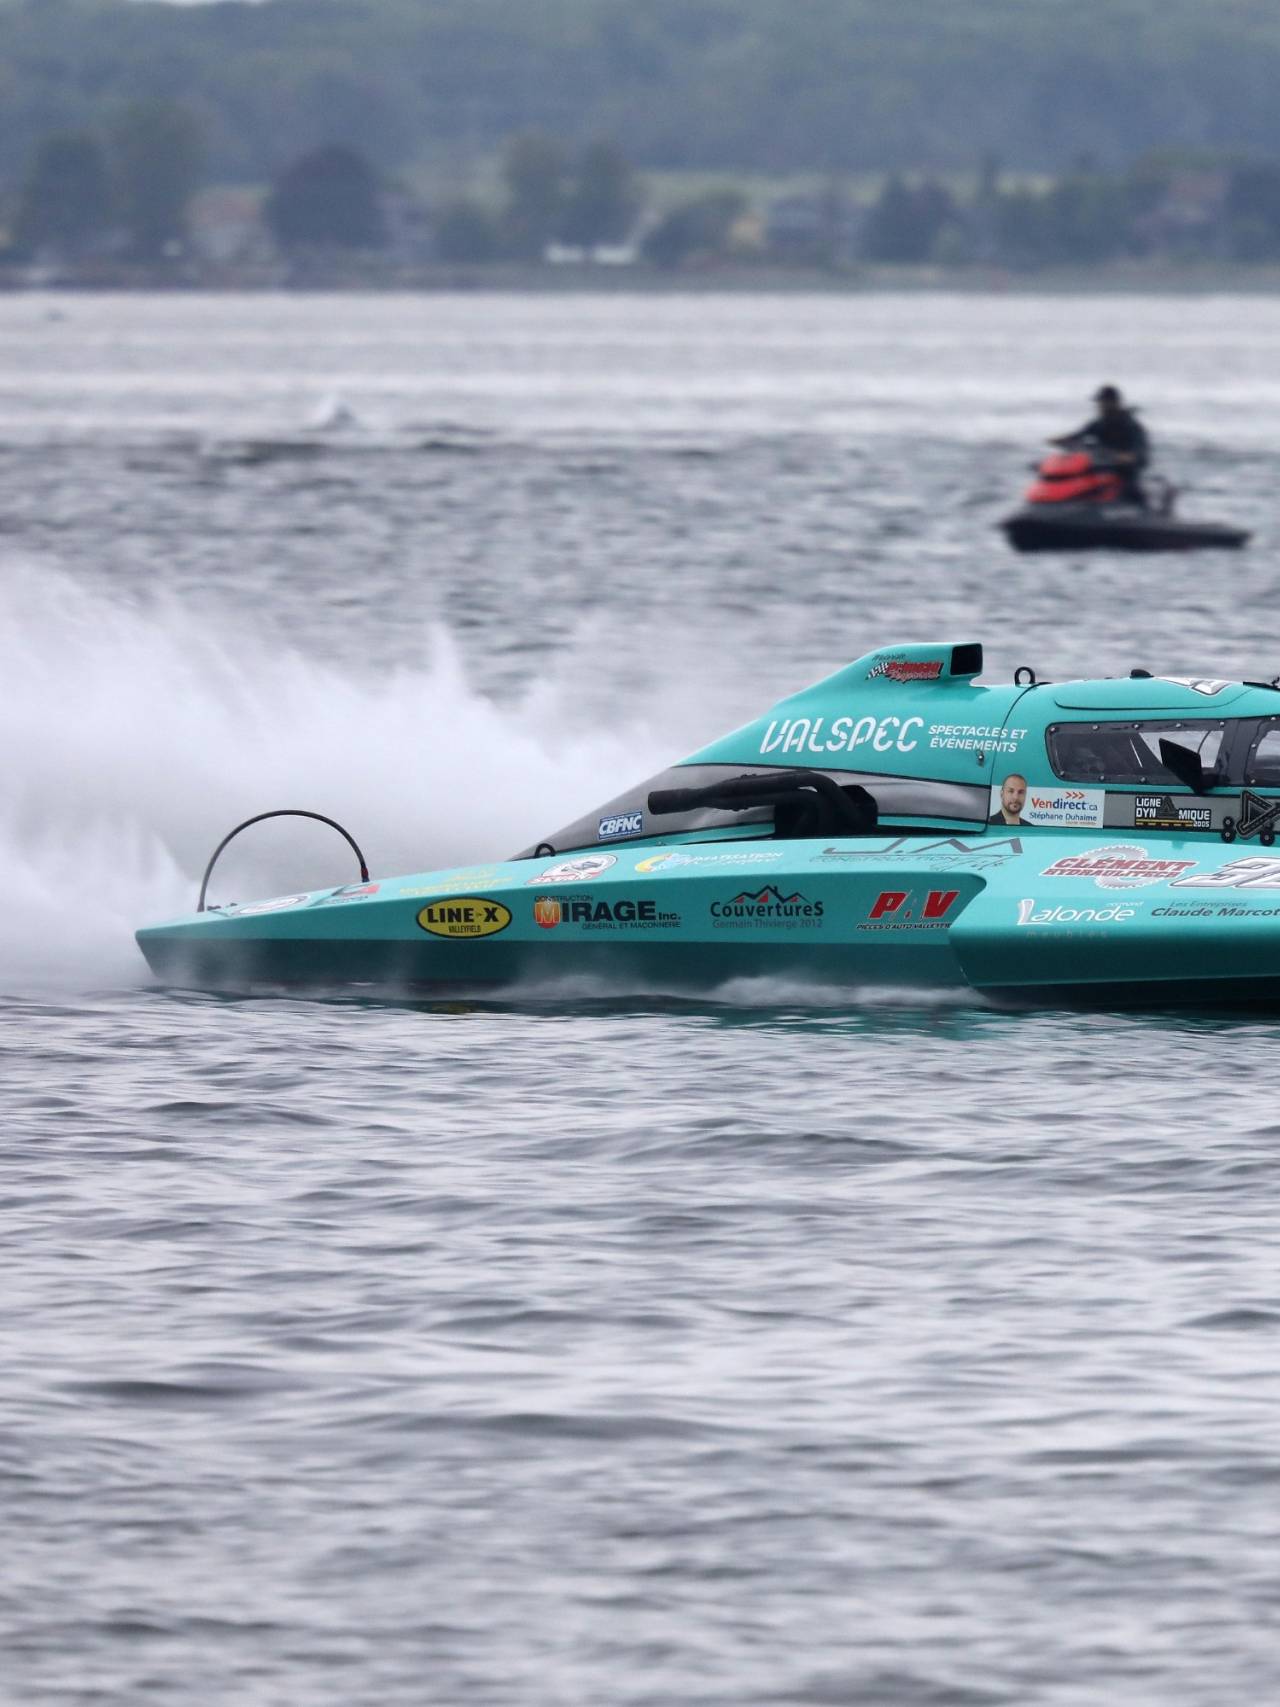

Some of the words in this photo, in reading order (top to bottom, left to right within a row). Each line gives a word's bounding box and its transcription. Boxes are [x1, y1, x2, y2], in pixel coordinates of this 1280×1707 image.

[759, 716, 924, 754] VALSPEC
[928, 724, 1008, 740] SPECTACLES
[1010, 728, 1028, 740] ET
[930, 734, 1018, 753] ÉVÉNEMENTS
[1136, 797, 1161, 807] LIGNE
[599, 815, 642, 835] CBFNC
[1029, 812, 1063, 821] Stéphane
[1065, 813, 1097, 822] Duhaime
[534, 900, 657, 924] MIRAGE
[658, 911, 681, 921] Inc.
[1016, 899, 1136, 926] Lalonde
[1151, 907, 1213, 917] Claude
[449, 924, 482, 933] VALLEYFIELD
